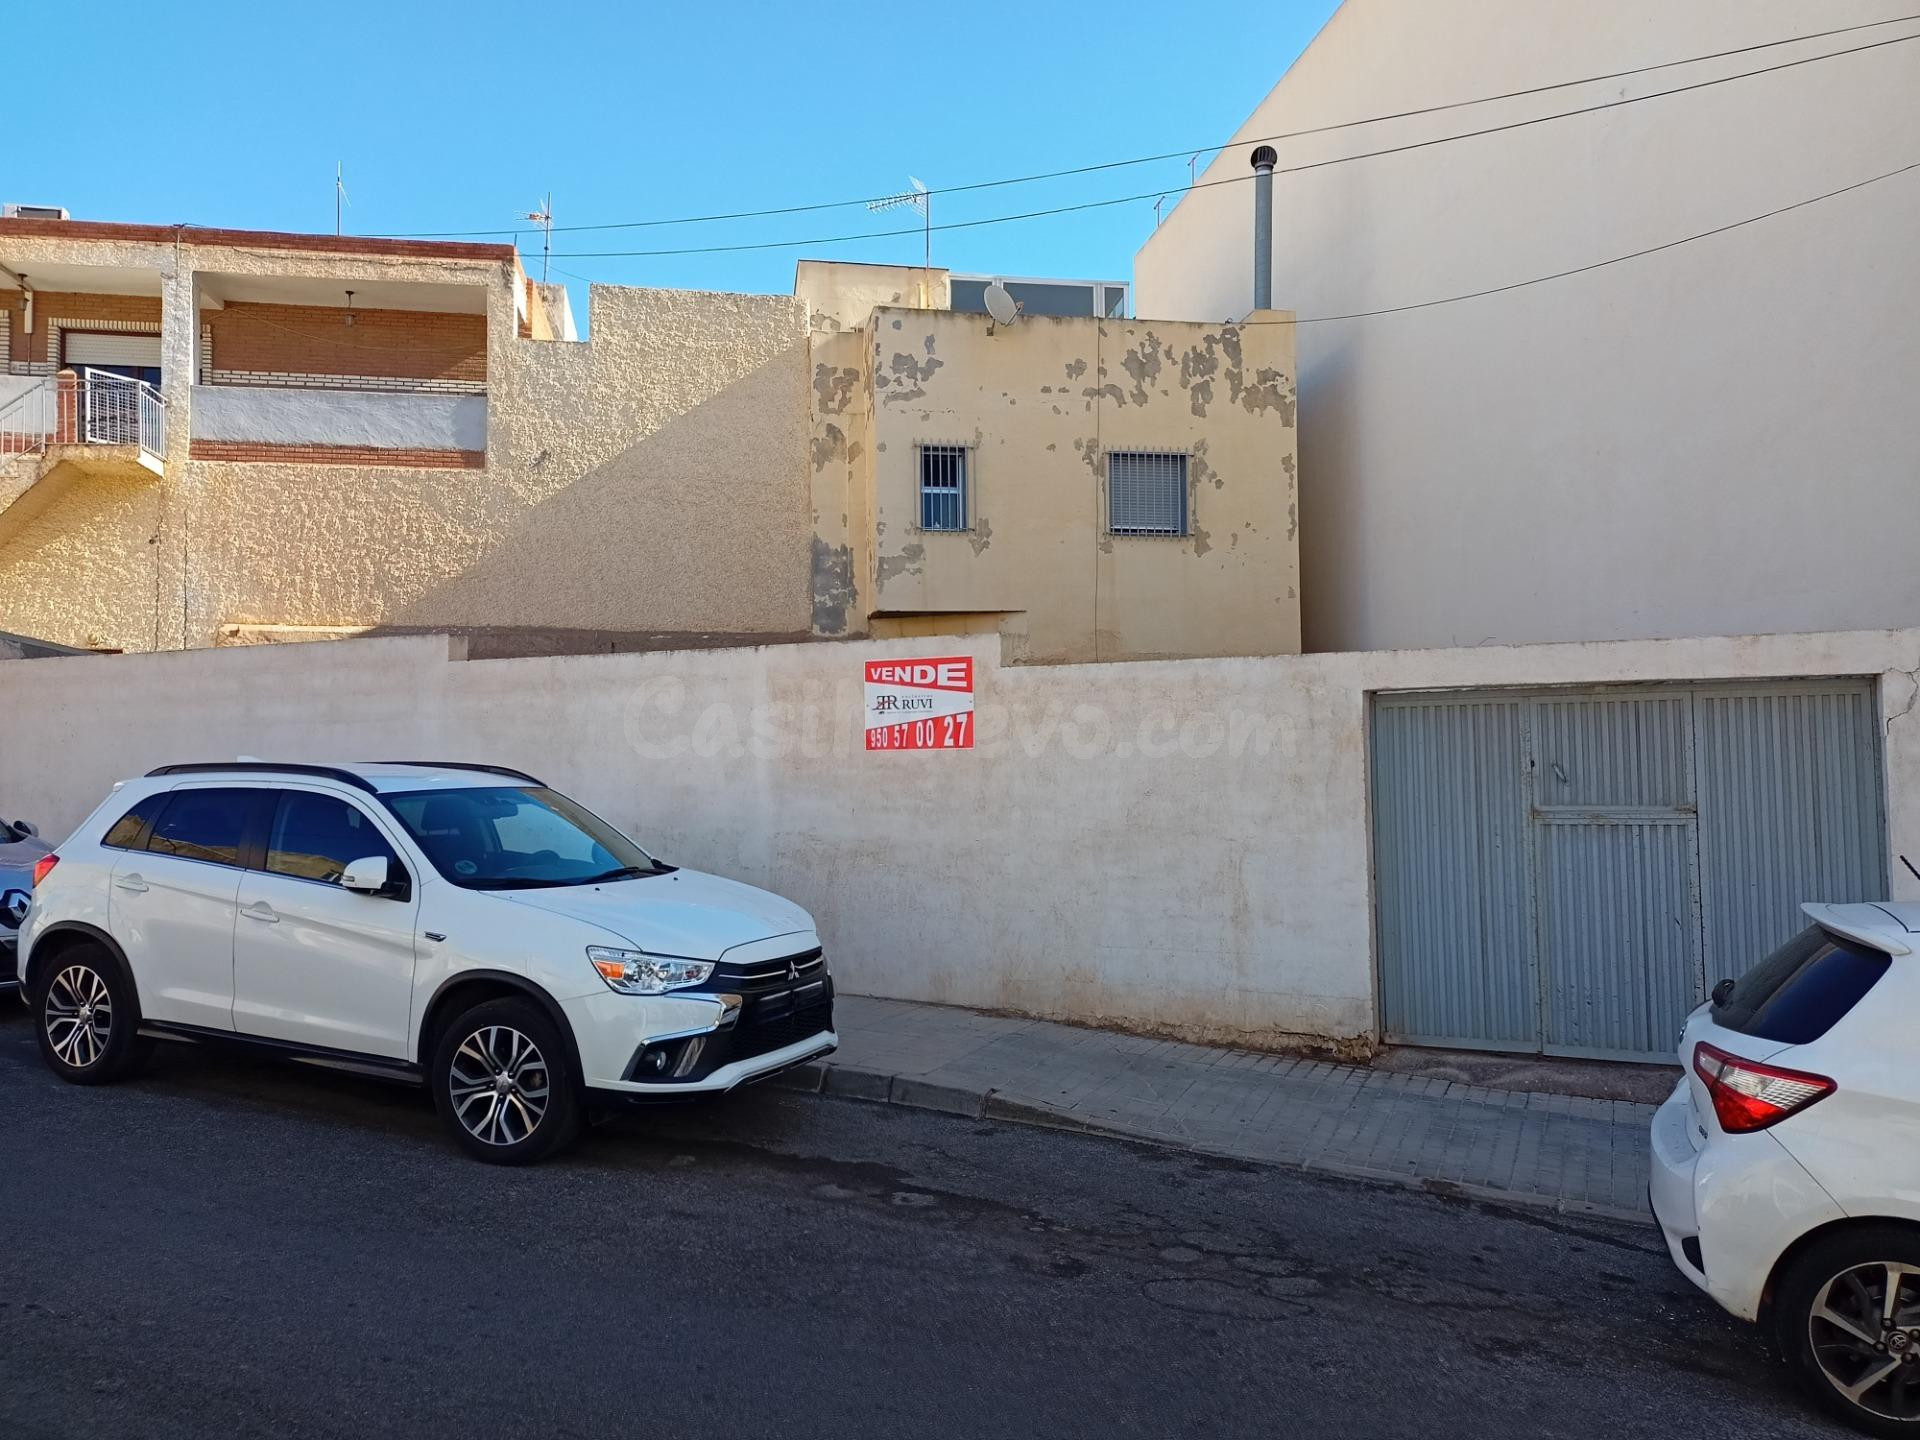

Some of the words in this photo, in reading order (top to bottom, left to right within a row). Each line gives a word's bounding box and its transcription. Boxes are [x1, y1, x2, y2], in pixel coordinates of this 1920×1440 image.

[870, 662, 968, 688] VENDE
[902, 698, 934, 710] RUVI
[870, 727, 888, 748] 950
[893, 723, 909, 747] 57
[916, 720, 935, 747] 00
[943, 713, 968, 747] 27
